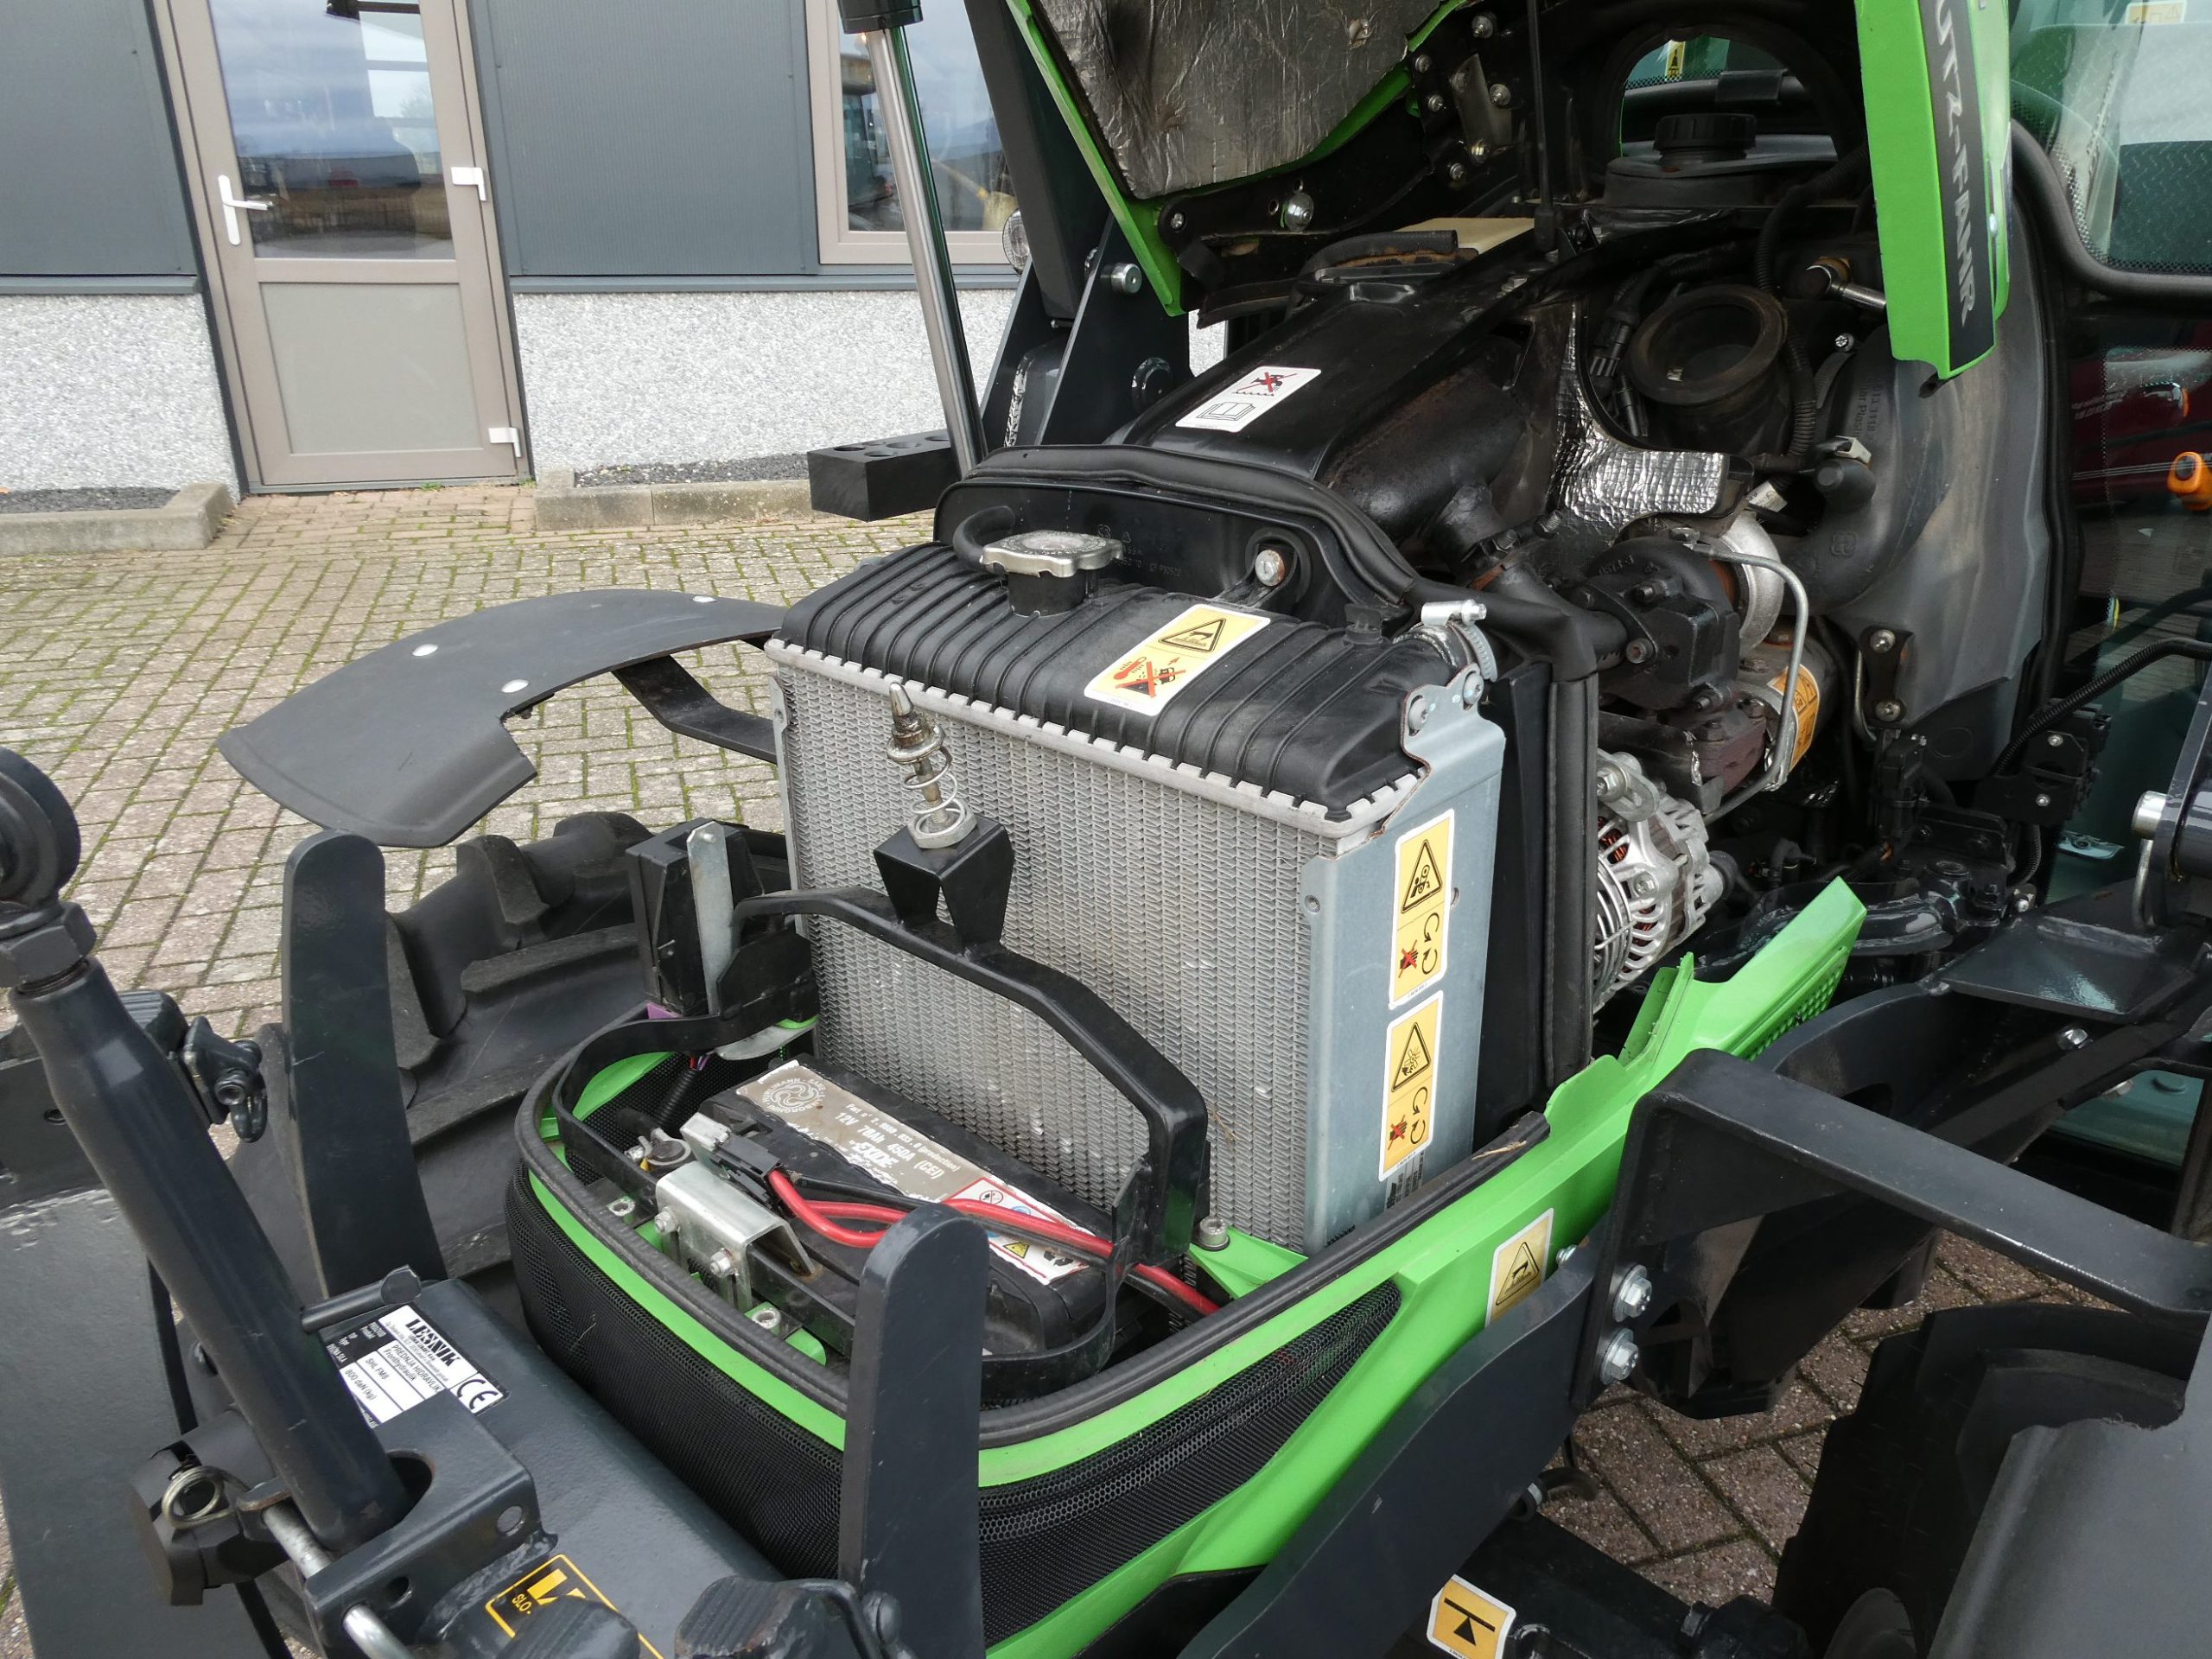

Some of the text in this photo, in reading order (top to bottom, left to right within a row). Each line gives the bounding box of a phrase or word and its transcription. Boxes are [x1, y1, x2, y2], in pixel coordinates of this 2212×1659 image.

[835, 1112, 860, 1126] 12V
[887, 1143, 916, 1162] 450A
[913, 1160, 945, 1179] (CEI)
[391, 1344, 416, 1368] PREDNJA
